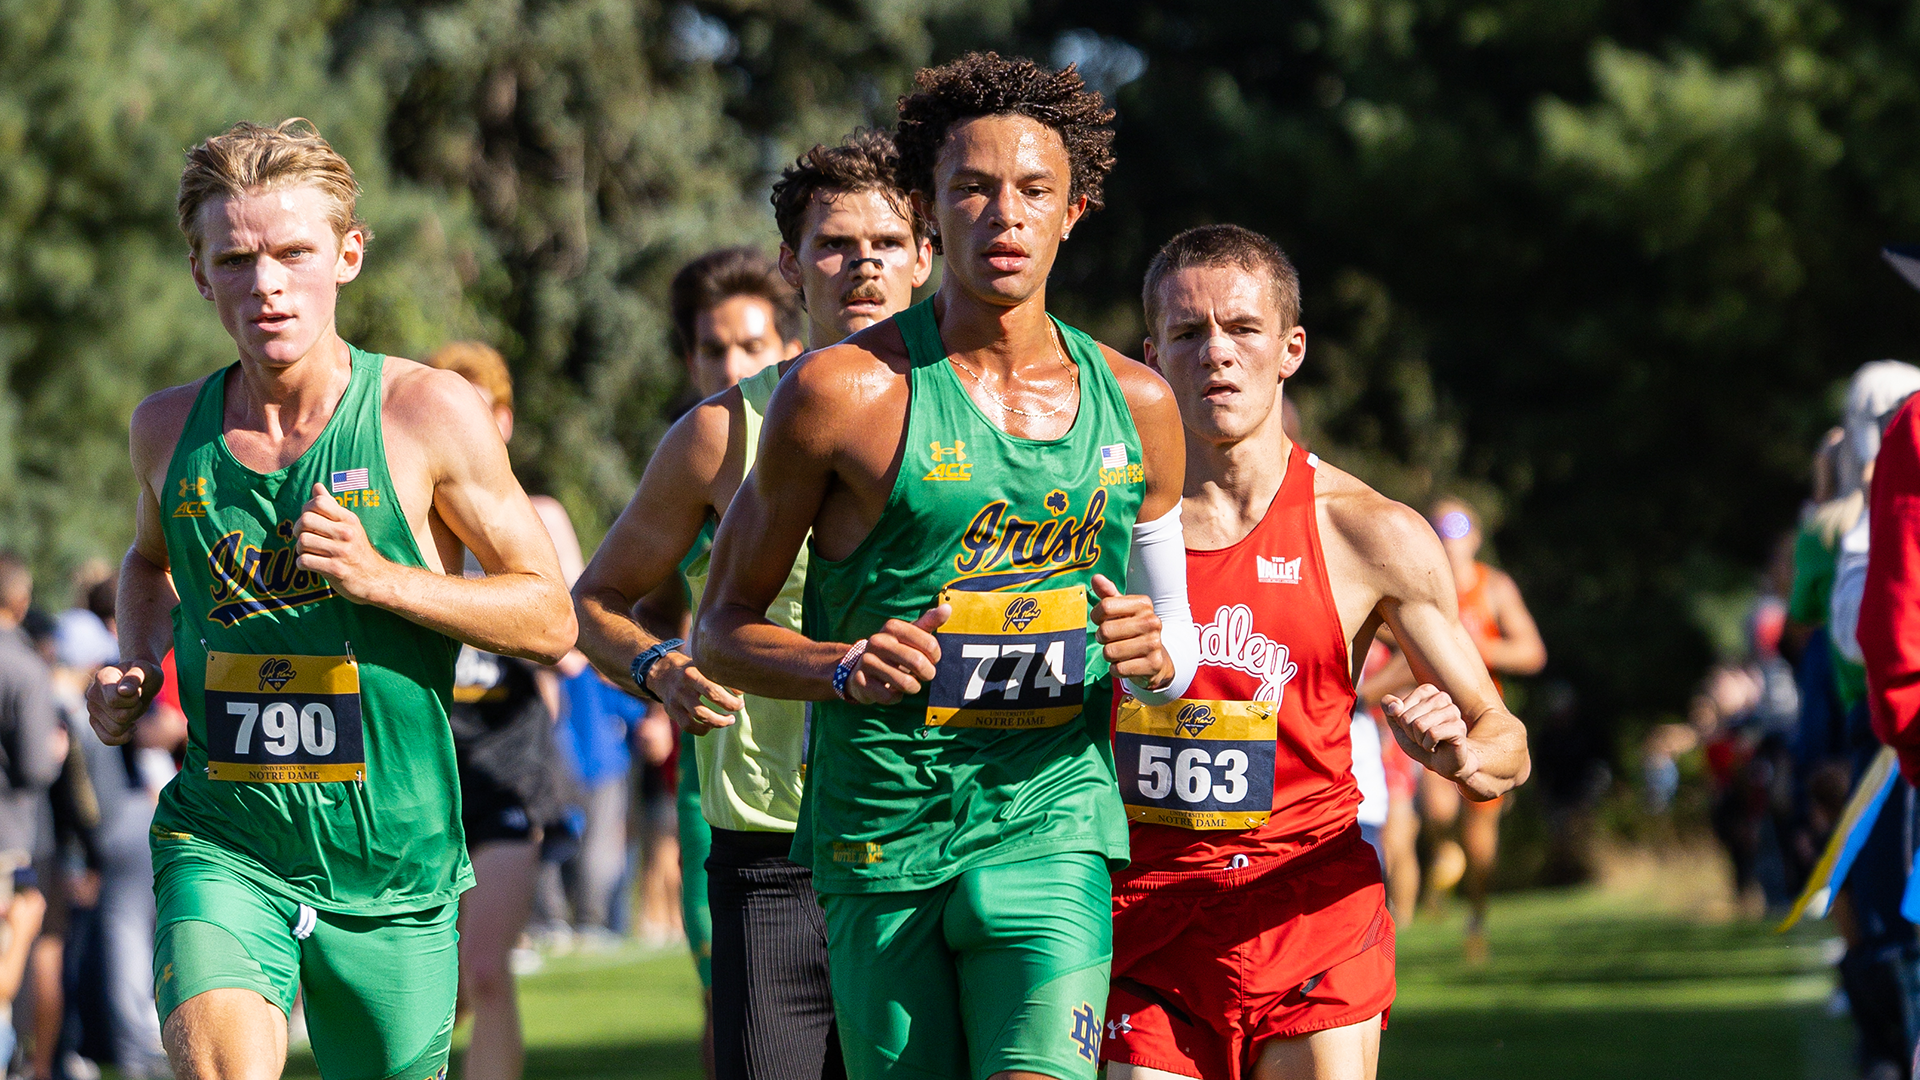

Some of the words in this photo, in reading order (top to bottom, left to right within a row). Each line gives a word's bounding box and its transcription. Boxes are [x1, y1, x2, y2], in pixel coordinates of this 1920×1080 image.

[922, 463, 973, 481] ACC
[1099, 467, 1127, 486] SoFi
[334, 490, 359, 508] oFi
[172, 501, 211, 517] ACC
[954, 486, 1108, 575] Irish
[1256, 554, 1302, 580] VALLEY
[961, 640, 1067, 700] 774
[226, 701, 337, 756] 790
[975, 717, 1014, 726] NOTRE
[1016, 716, 1046, 726] DAME
[249, 771, 286, 780] NOTRE
[288, 771, 320, 780] DAME
[1137, 744, 1249, 803] 563
[1158, 814, 1193, 826] NOTRE
[1195, 817, 1227, 827] DAME
